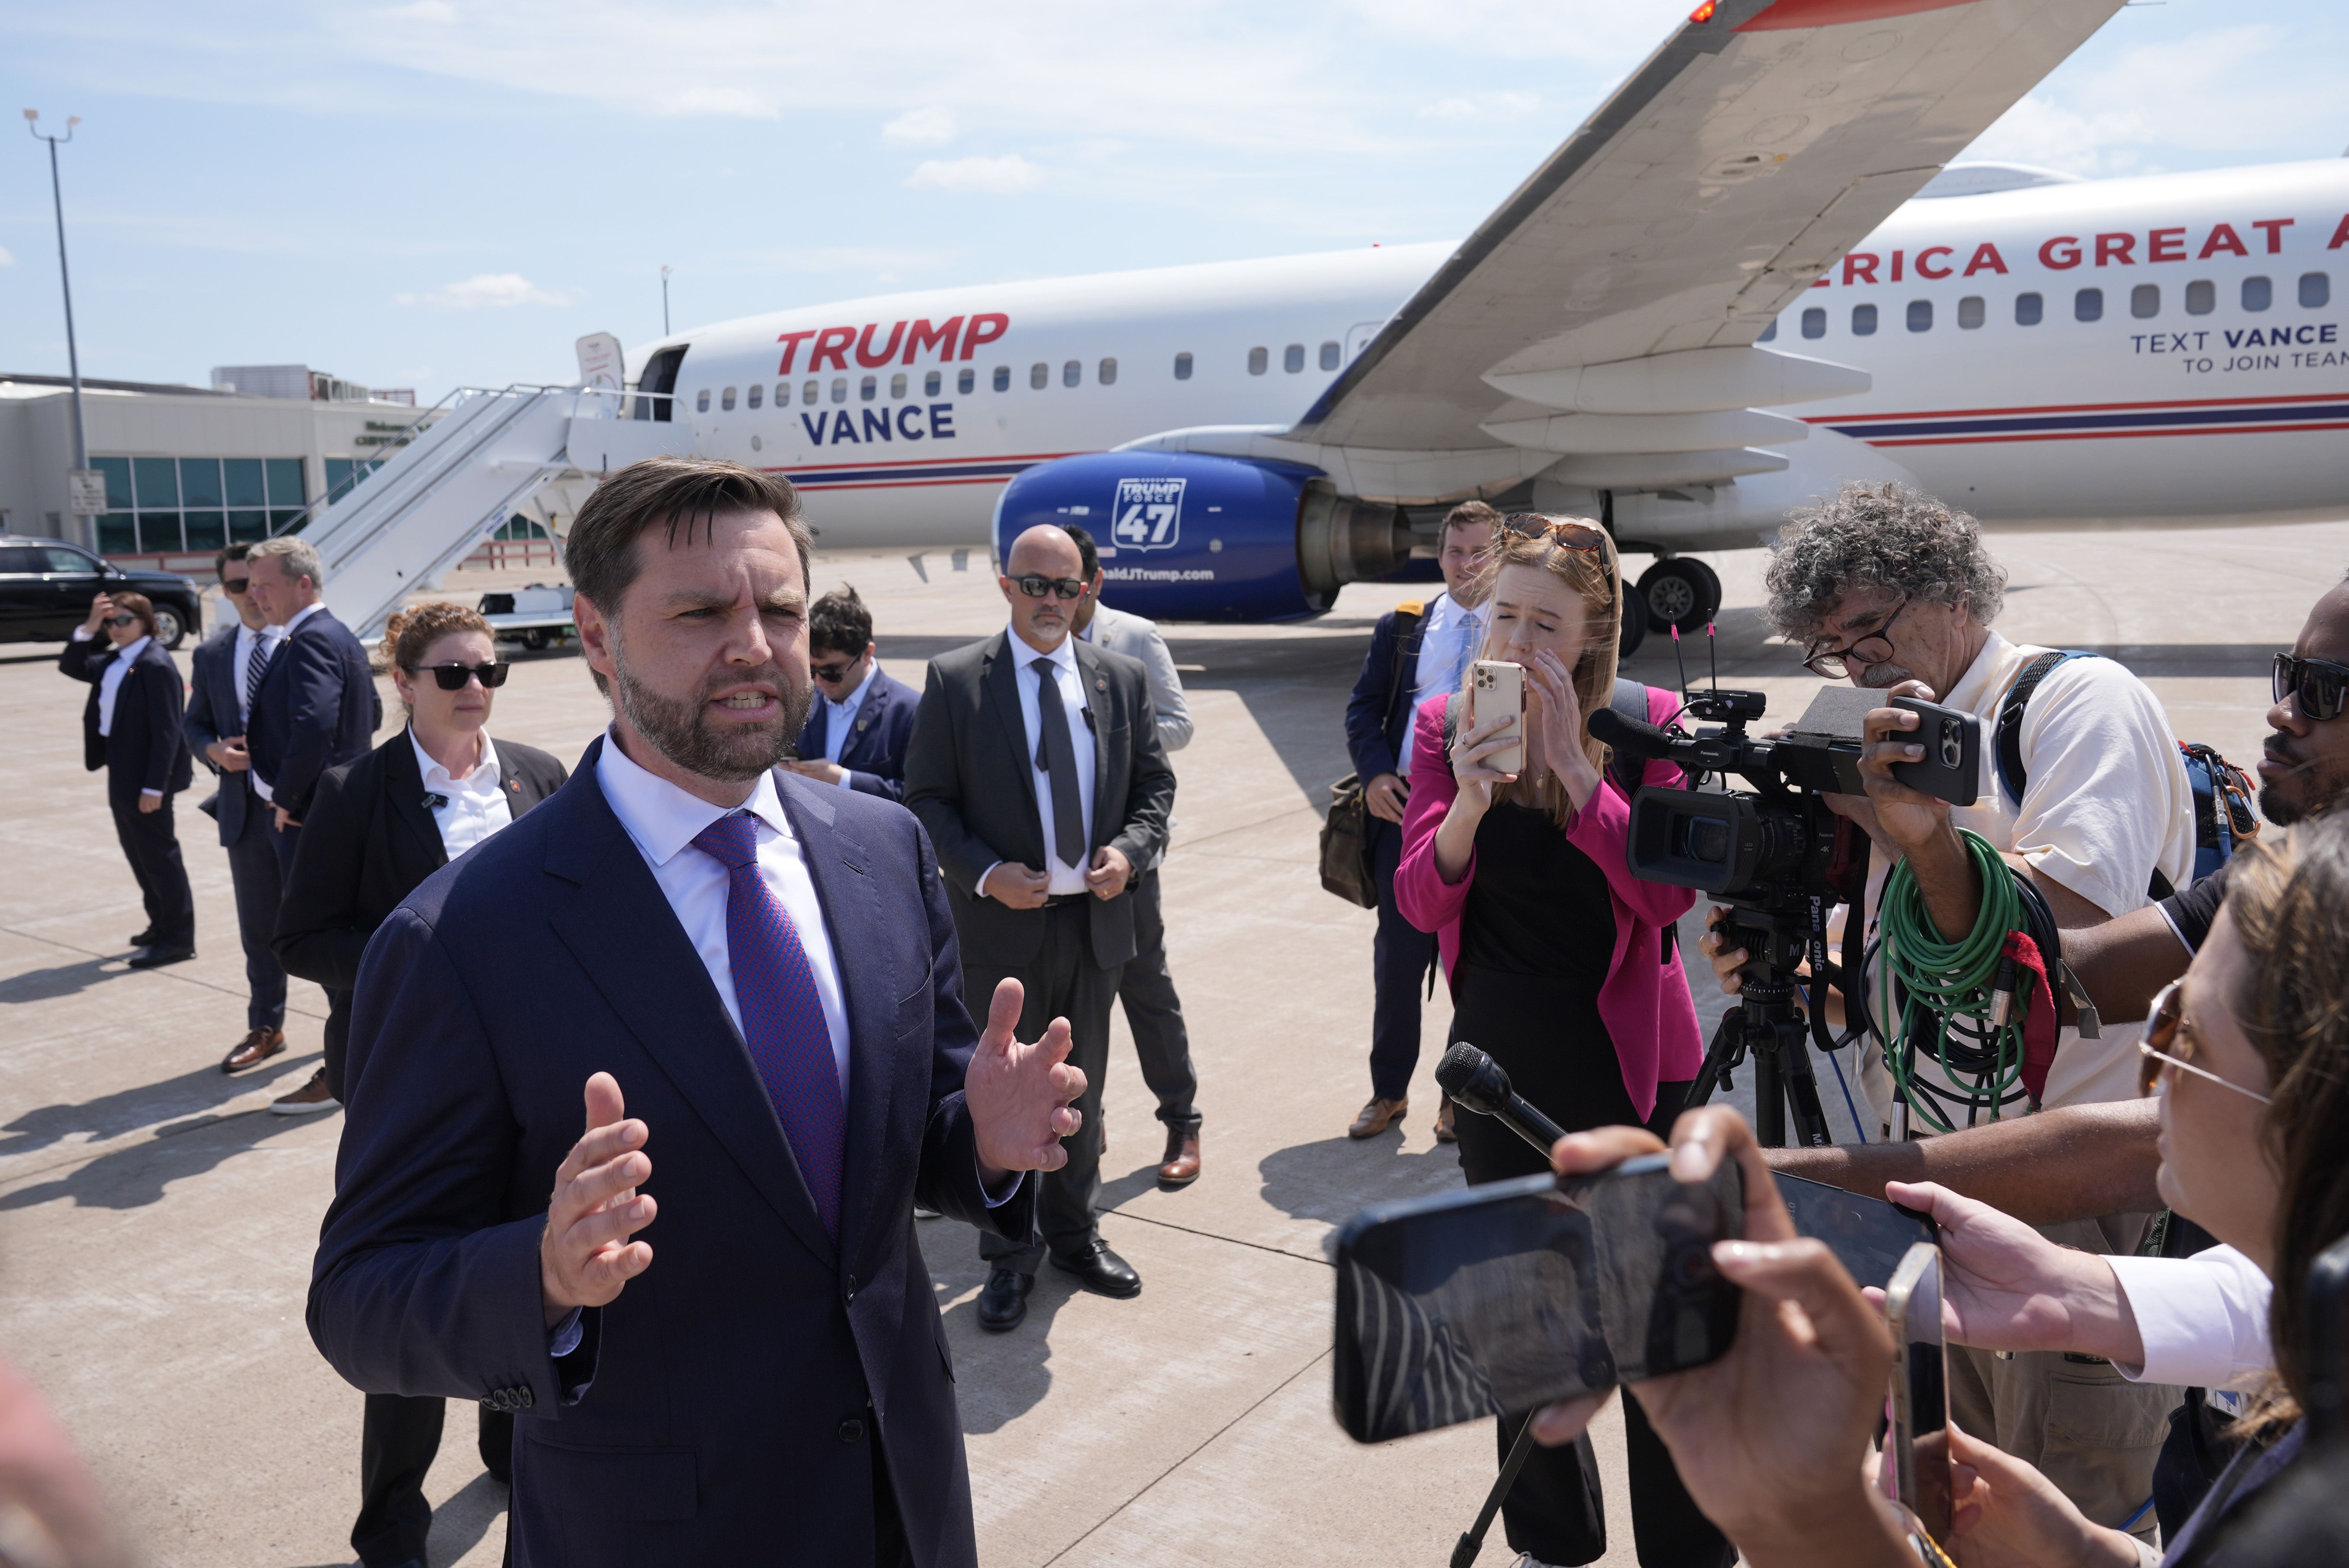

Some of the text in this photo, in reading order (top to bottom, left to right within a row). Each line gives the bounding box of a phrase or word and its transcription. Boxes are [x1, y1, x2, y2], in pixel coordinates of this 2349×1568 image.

[1810, 242, 2009, 288] RICA
[2037, 218, 2295, 270] GREAT
[777, 313, 1010, 376] TRUMP
[2131, 324, 2338, 354] TEXT VANCE
[2183, 358, 2213, 374] TO
[2223, 354, 2280, 372] JOIN
[801, 403, 956, 446] VANCE
[1122, 483, 1181, 495] TRUMP
[1123, 495, 1174, 503] FORCE
[1116, 504, 1176, 543] 47
[1103, 567, 1214, 583] naldJTrump.com
[1809, 895, 1825, 972] Panaonic
[1789, 944, 1800, 956] M
